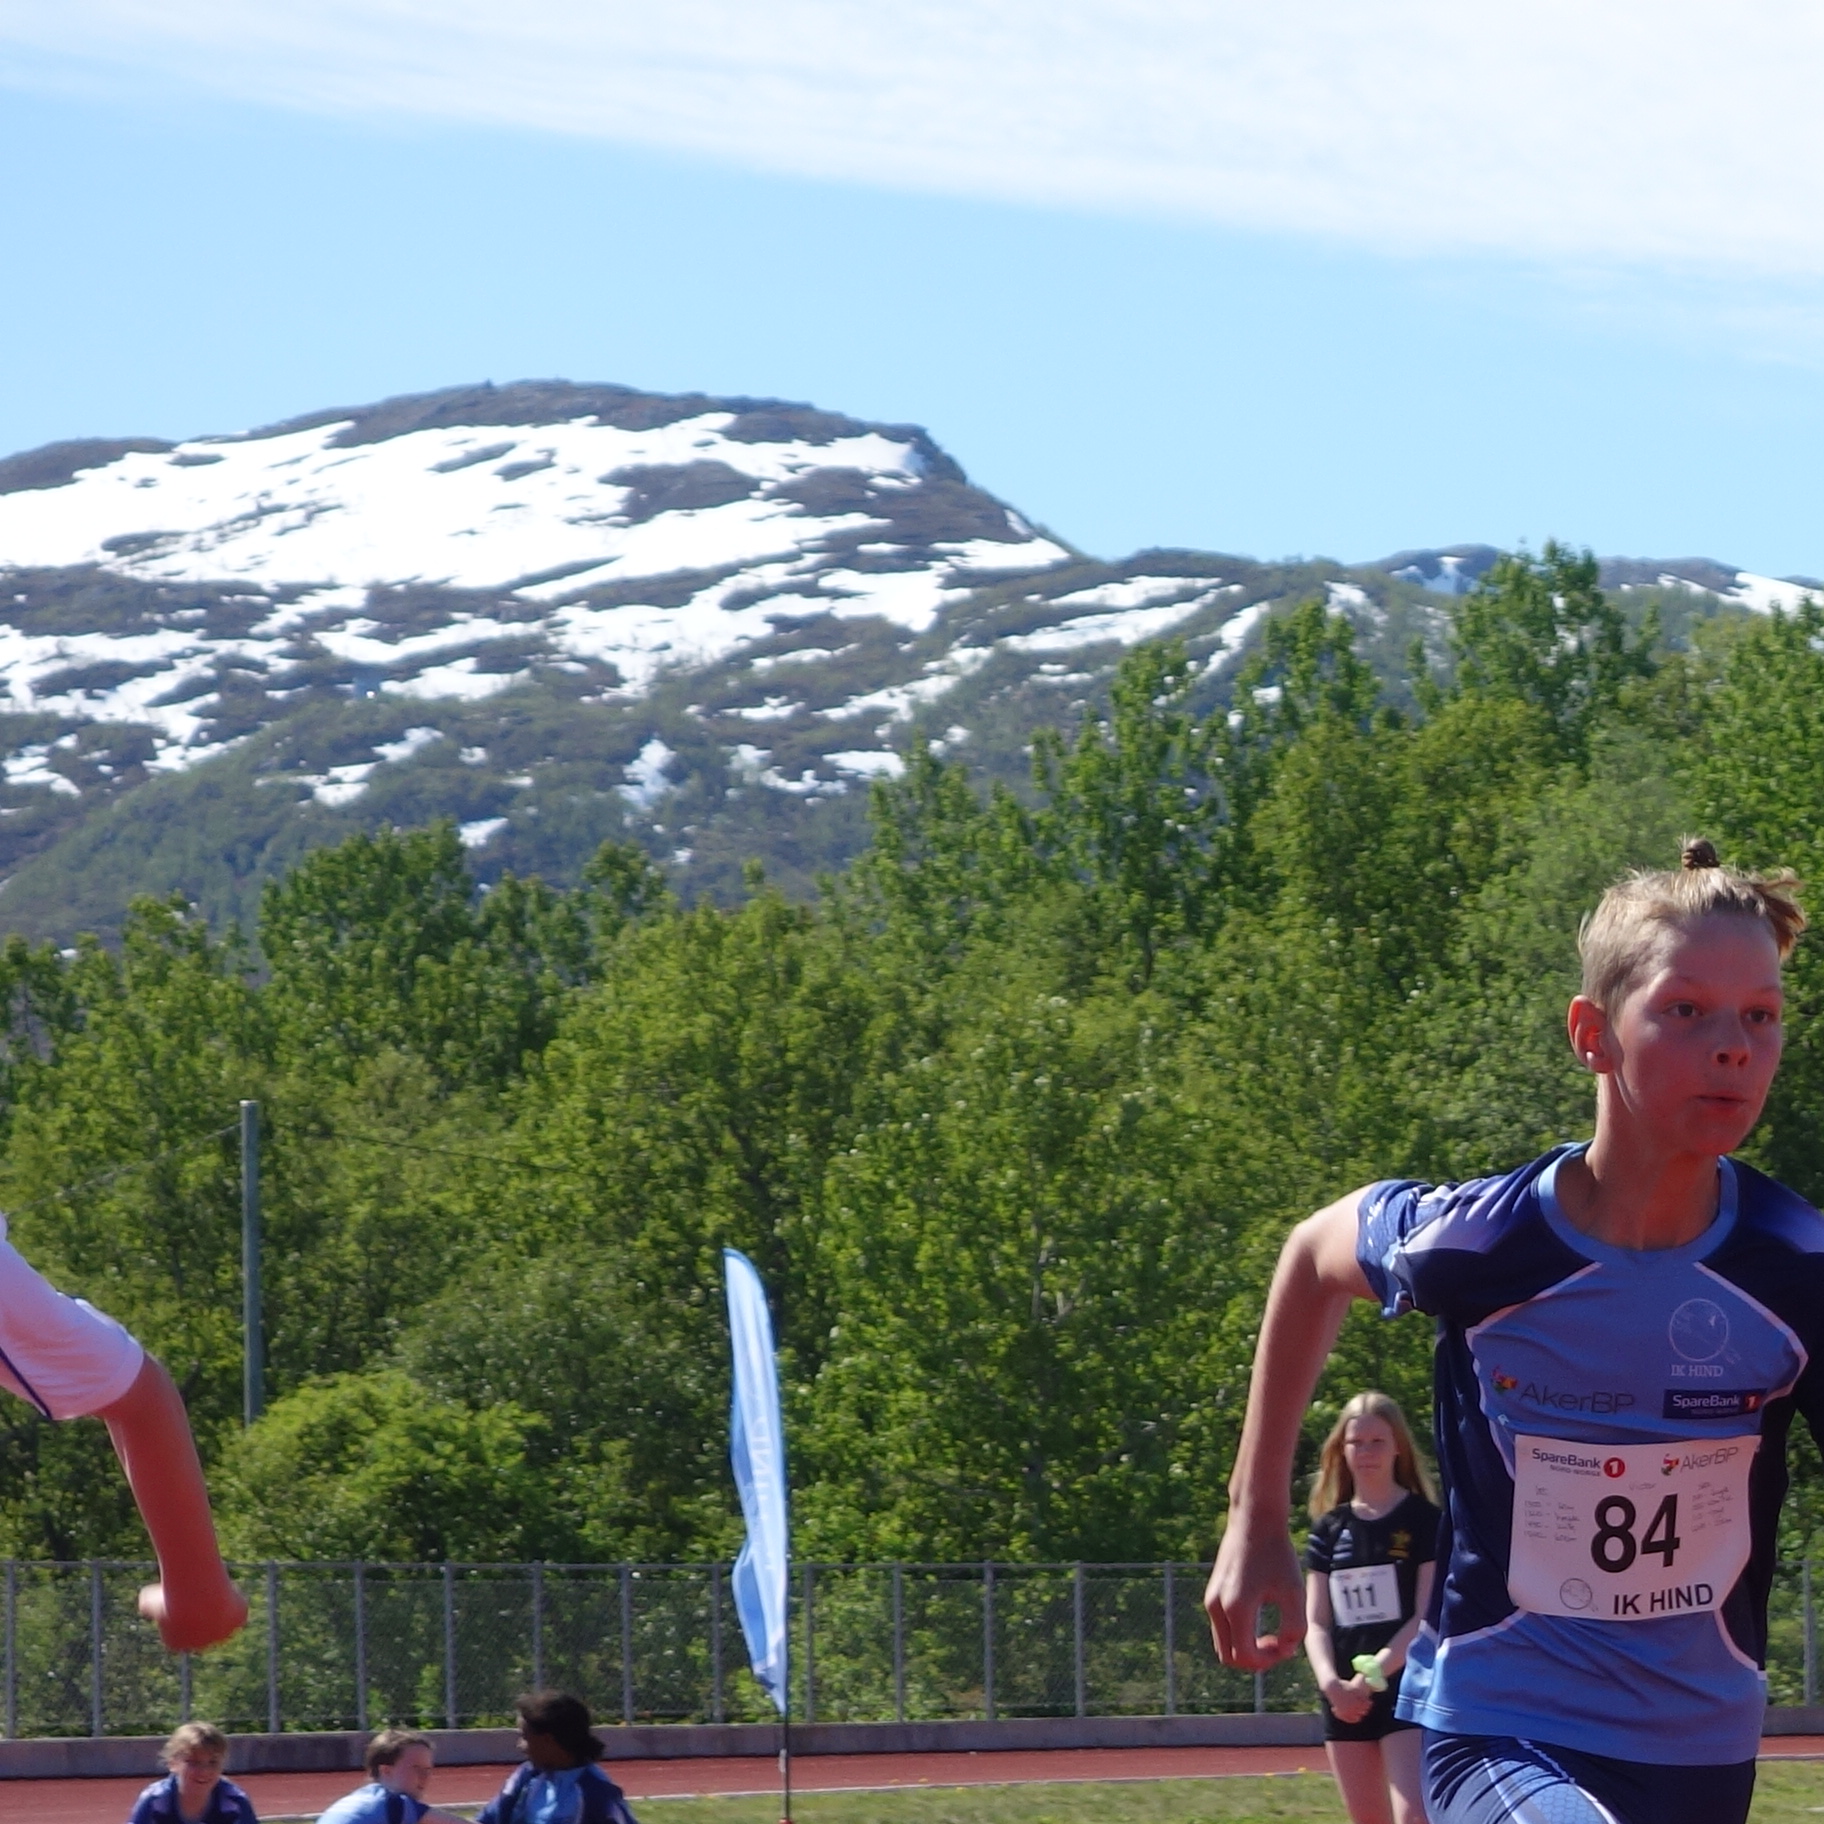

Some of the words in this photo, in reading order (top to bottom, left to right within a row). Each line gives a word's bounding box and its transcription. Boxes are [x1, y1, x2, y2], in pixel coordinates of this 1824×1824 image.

[1670, 1364, 1685, 1376] IK
[1687, 1364, 1724, 1377] HIND
[1519, 1381, 1635, 1415] AkerBP
[1672, 1394, 1740, 1409] SpareBank
[1532, 1447, 1601, 1469] SpareBank
[1680, 1446, 1738, 1473] AkerBP
[1591, 1493, 1681, 1573] 84
[1341, 1583, 1377, 1610] 111
[1613, 1594, 1642, 1616] IK
[1650, 1583, 1714, 1613] HIND
